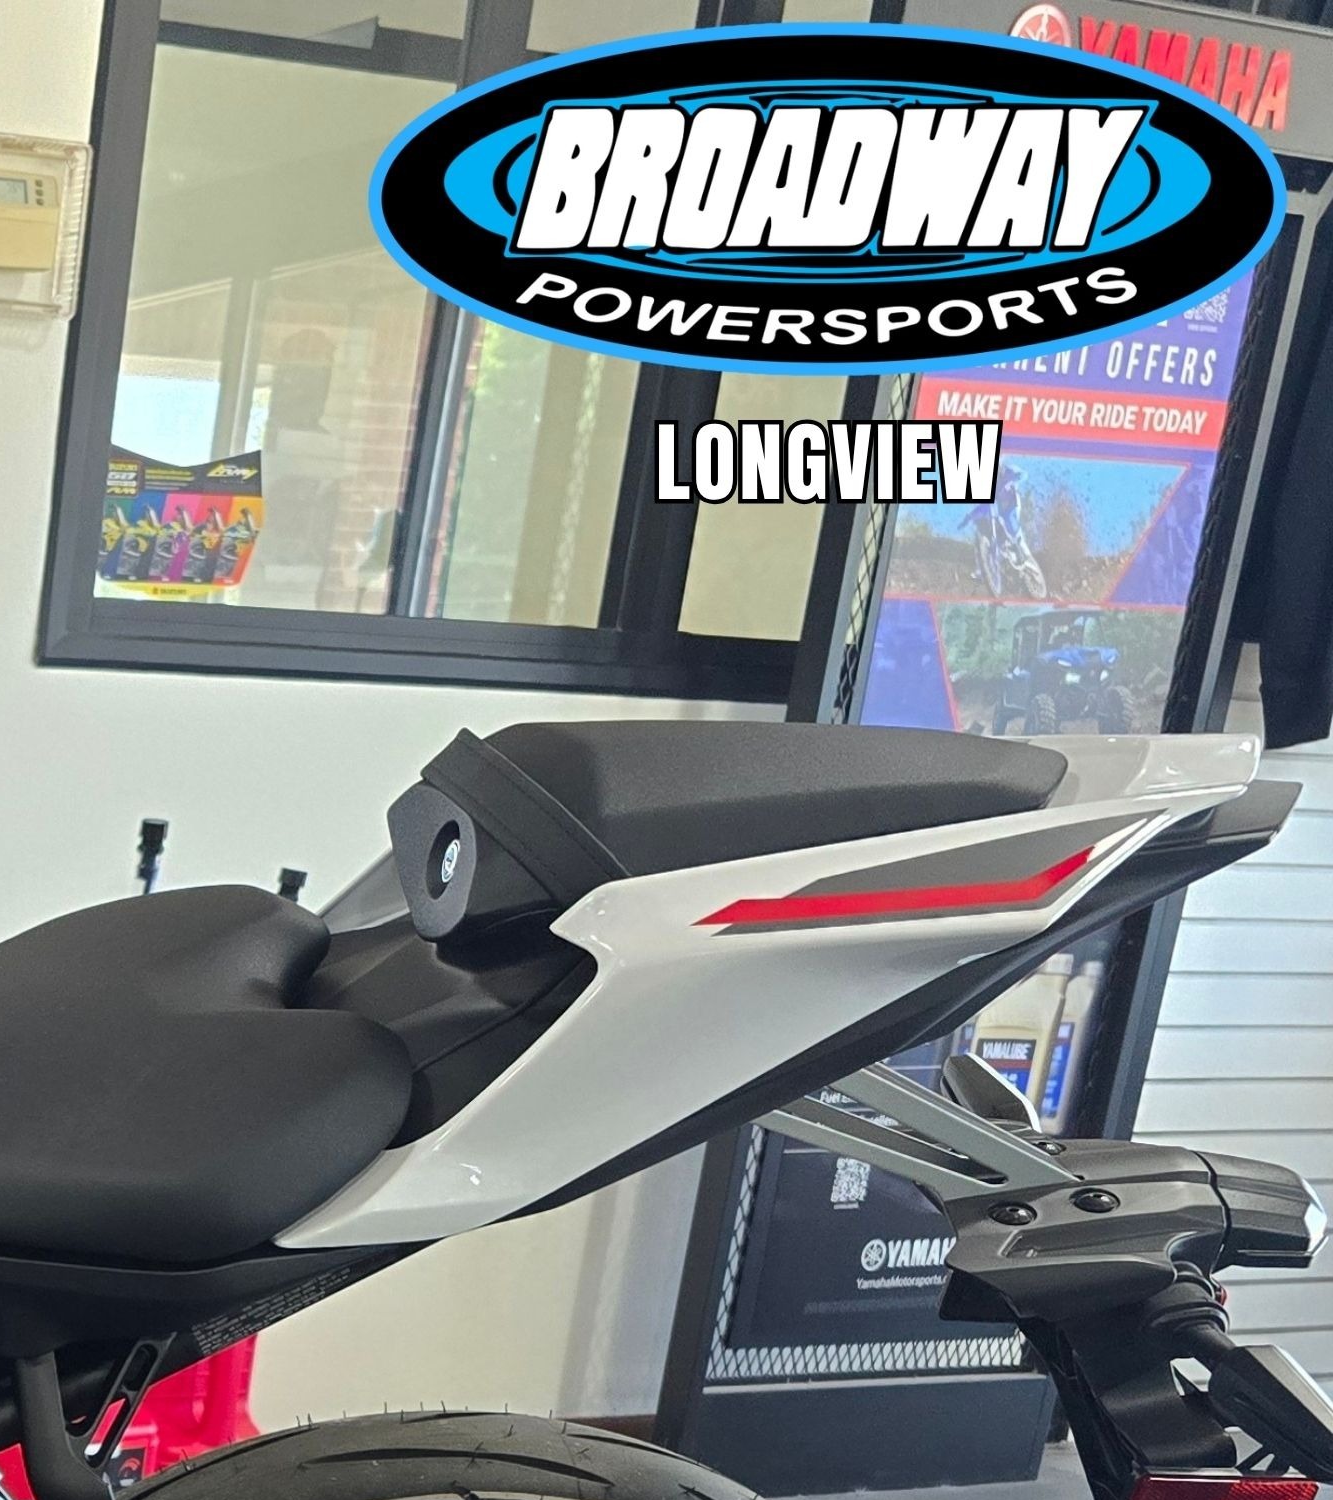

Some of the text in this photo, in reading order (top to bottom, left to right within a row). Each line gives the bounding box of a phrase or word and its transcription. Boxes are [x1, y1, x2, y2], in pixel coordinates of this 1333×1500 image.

[1105, 340, 1217, 387] OFFERS
[937, 390, 1208, 436] MAKE IT YOUR RIDE TODAY
[887, 1236, 957, 1268] YAMAH
